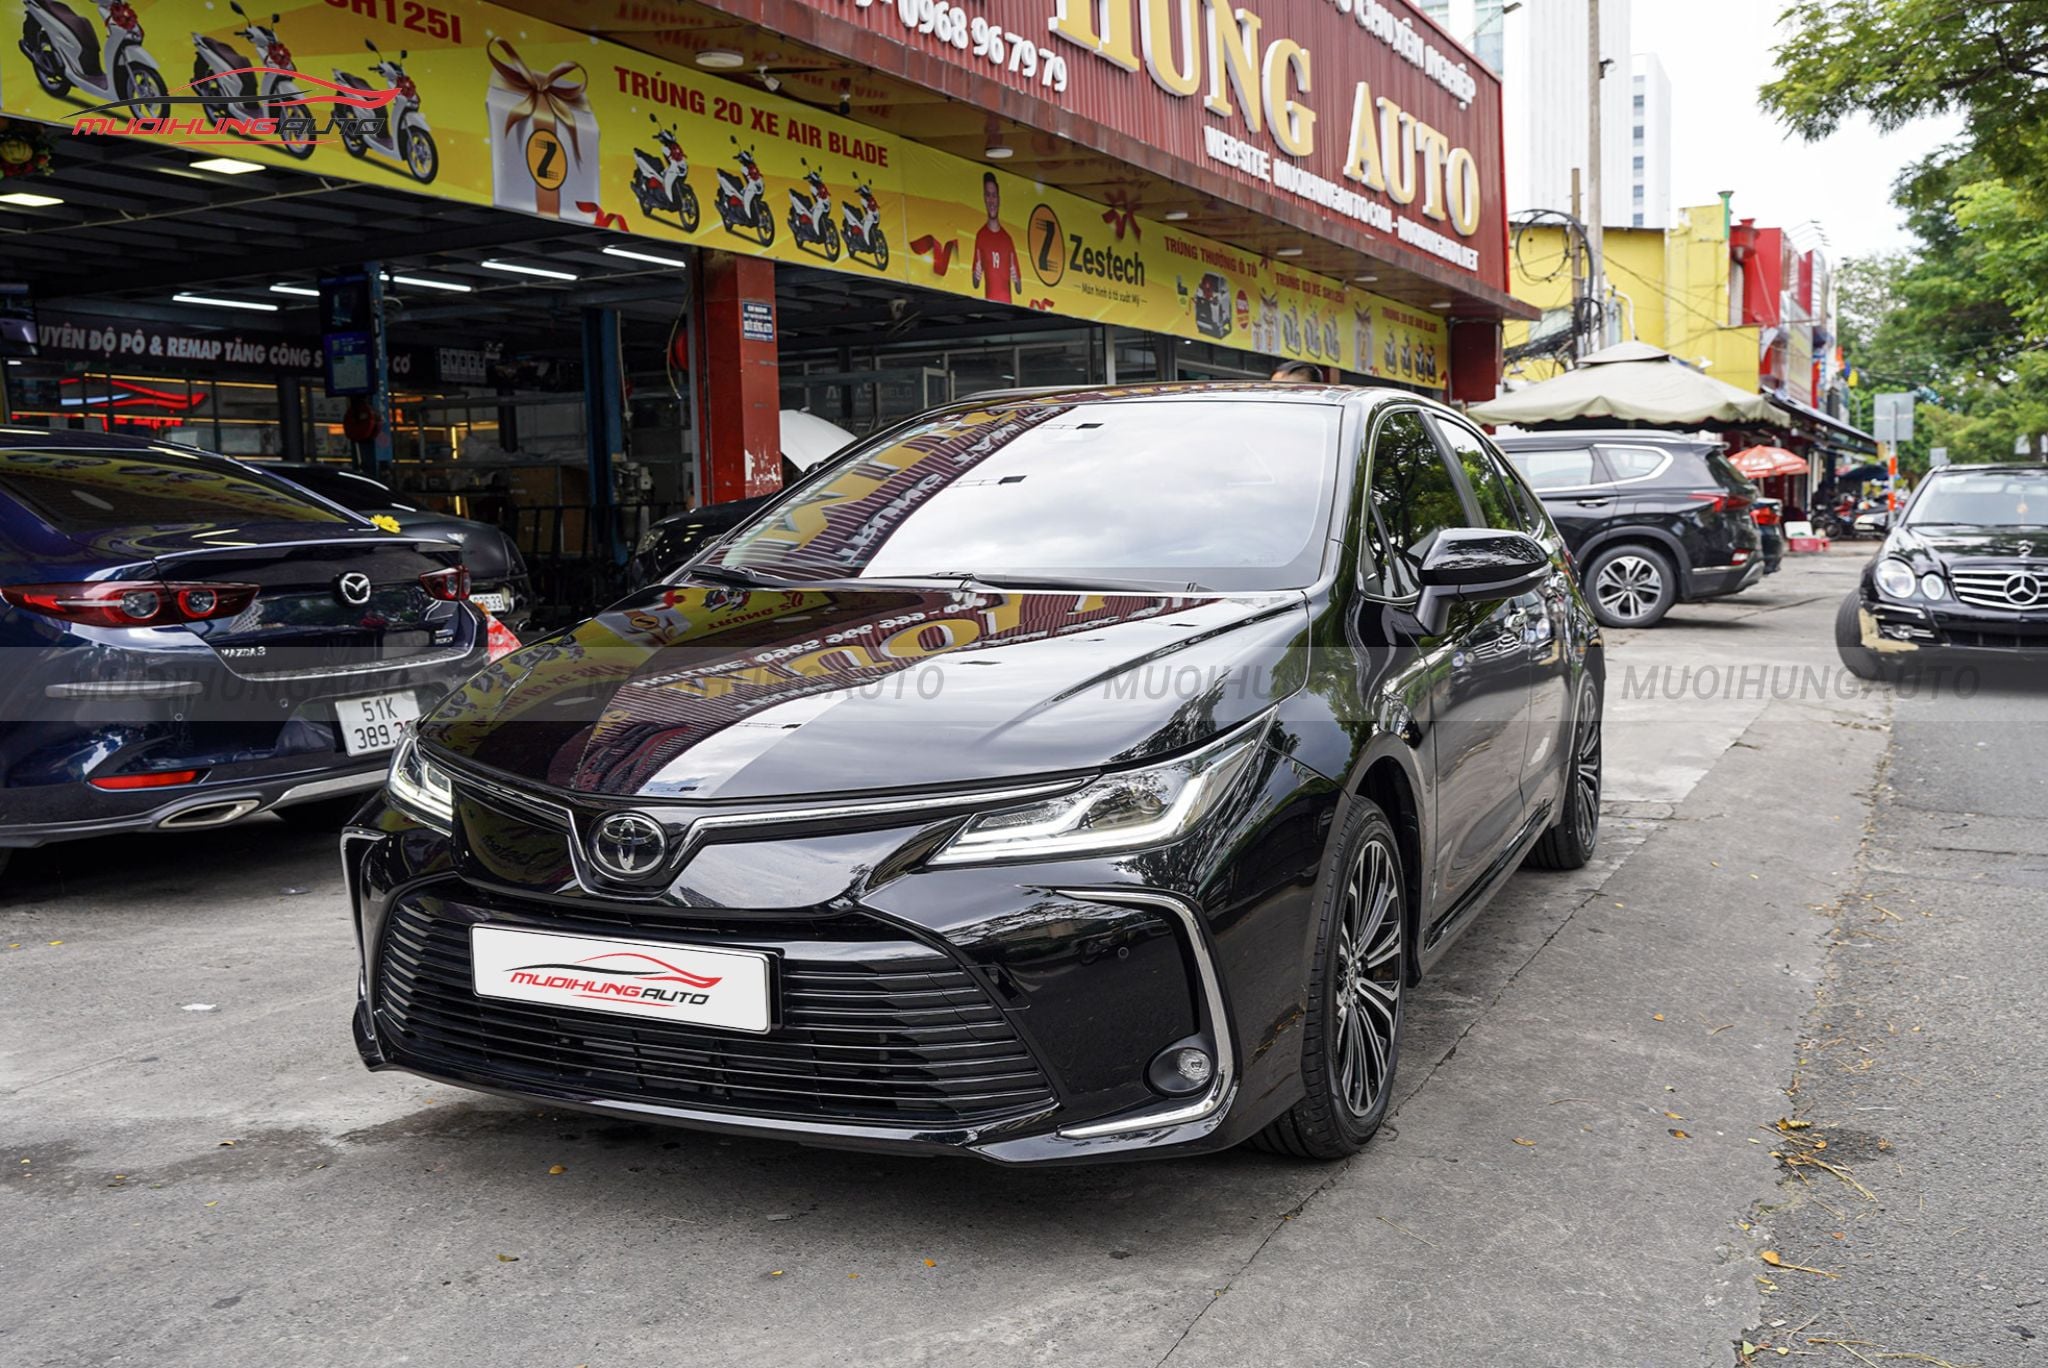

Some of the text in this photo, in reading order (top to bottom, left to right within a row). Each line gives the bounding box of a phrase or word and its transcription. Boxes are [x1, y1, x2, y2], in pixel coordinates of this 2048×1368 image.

[325, 0, 462, 44] H125I
[898, 0, 1068, 92] 0968 96 79 79
[614, 65, 888, 168] TRÚNG 20 XE AIR BLADE
[1343, 81, 1481, 236] AUTO
[1070, 233, 1145, 287] Zestech
[89, 326, 117, 358] ĐỘ
[120, 328, 146, 354] PÔ
[150, 335, 163, 356] &
[167, 336, 222, 361] REMAP
[224, 336, 267, 364] TĂNG
[269, 342, 311, 367] CÔNG
[361, 697, 398, 722] 51K
[354, 720, 411, 749] 389.
